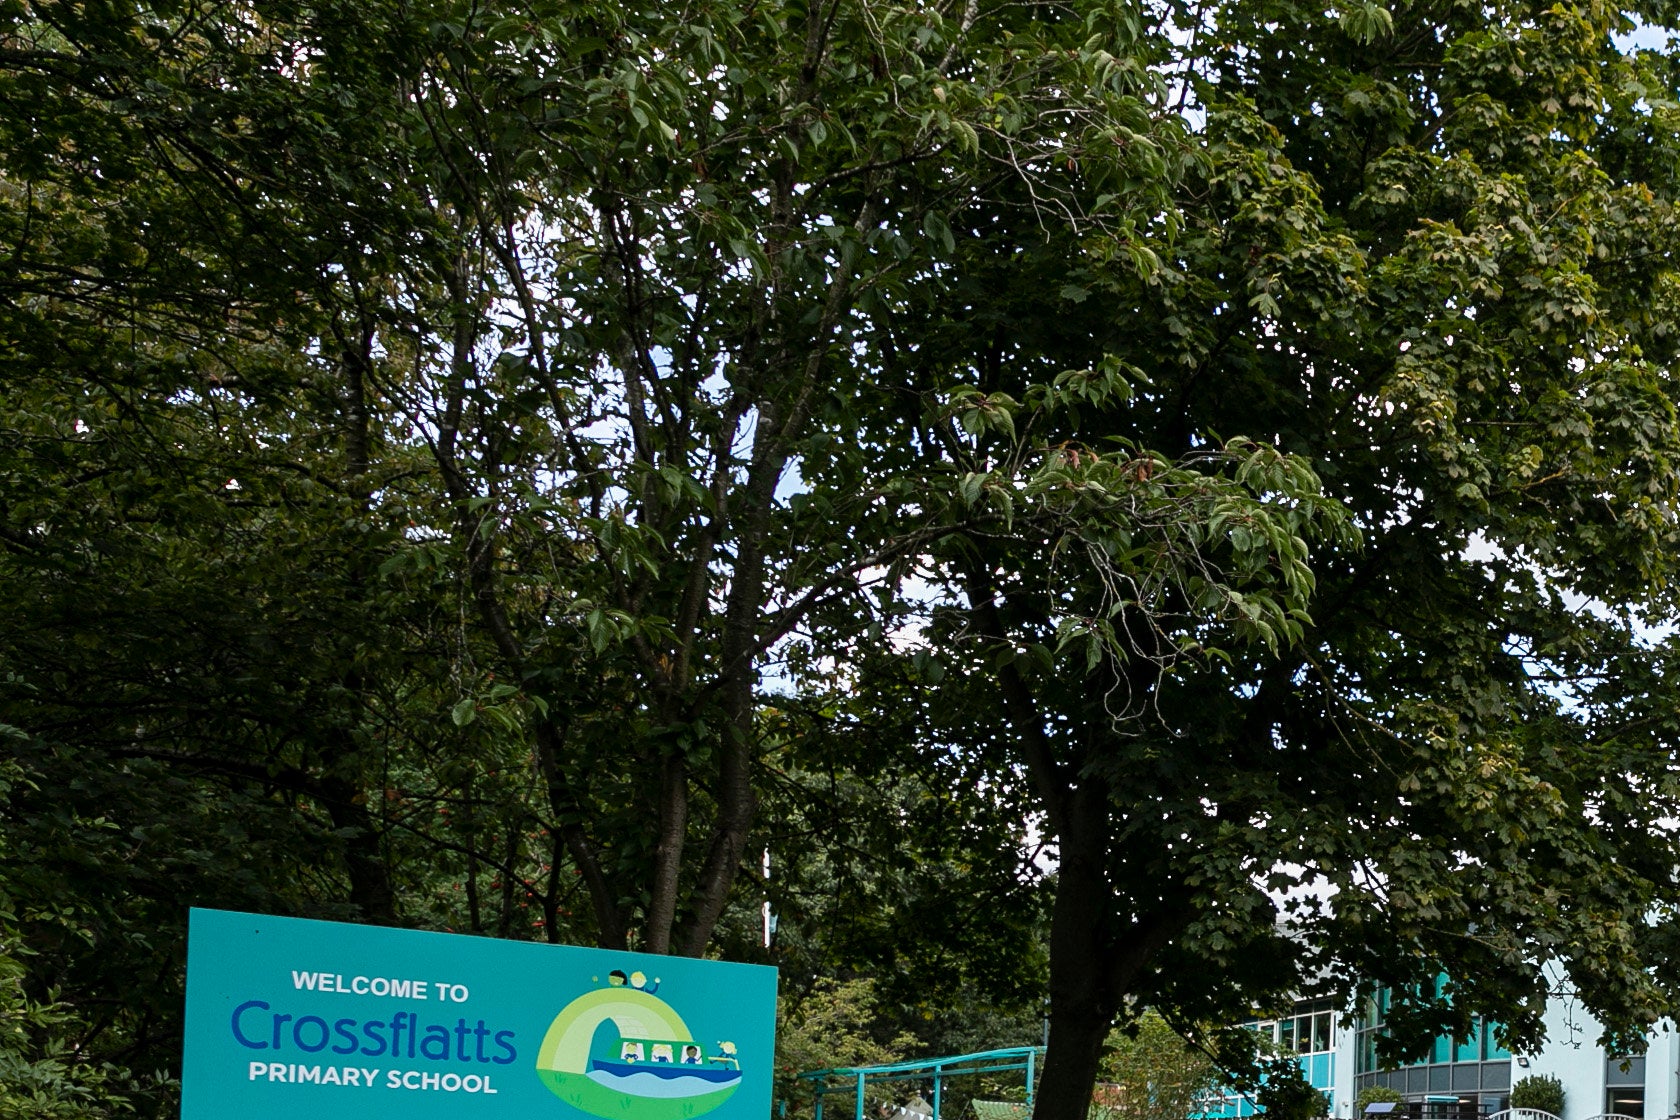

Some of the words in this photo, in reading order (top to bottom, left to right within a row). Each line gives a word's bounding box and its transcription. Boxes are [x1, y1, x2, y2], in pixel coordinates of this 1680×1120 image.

[292, 970, 428, 1000] WELCOME
[435, 982, 469, 1003] TO
[231, 1000, 517, 1064] Crossflatts
[249, 1061, 380, 1087] PRIMARY
[386, 1070, 498, 1094] SCHOOL
